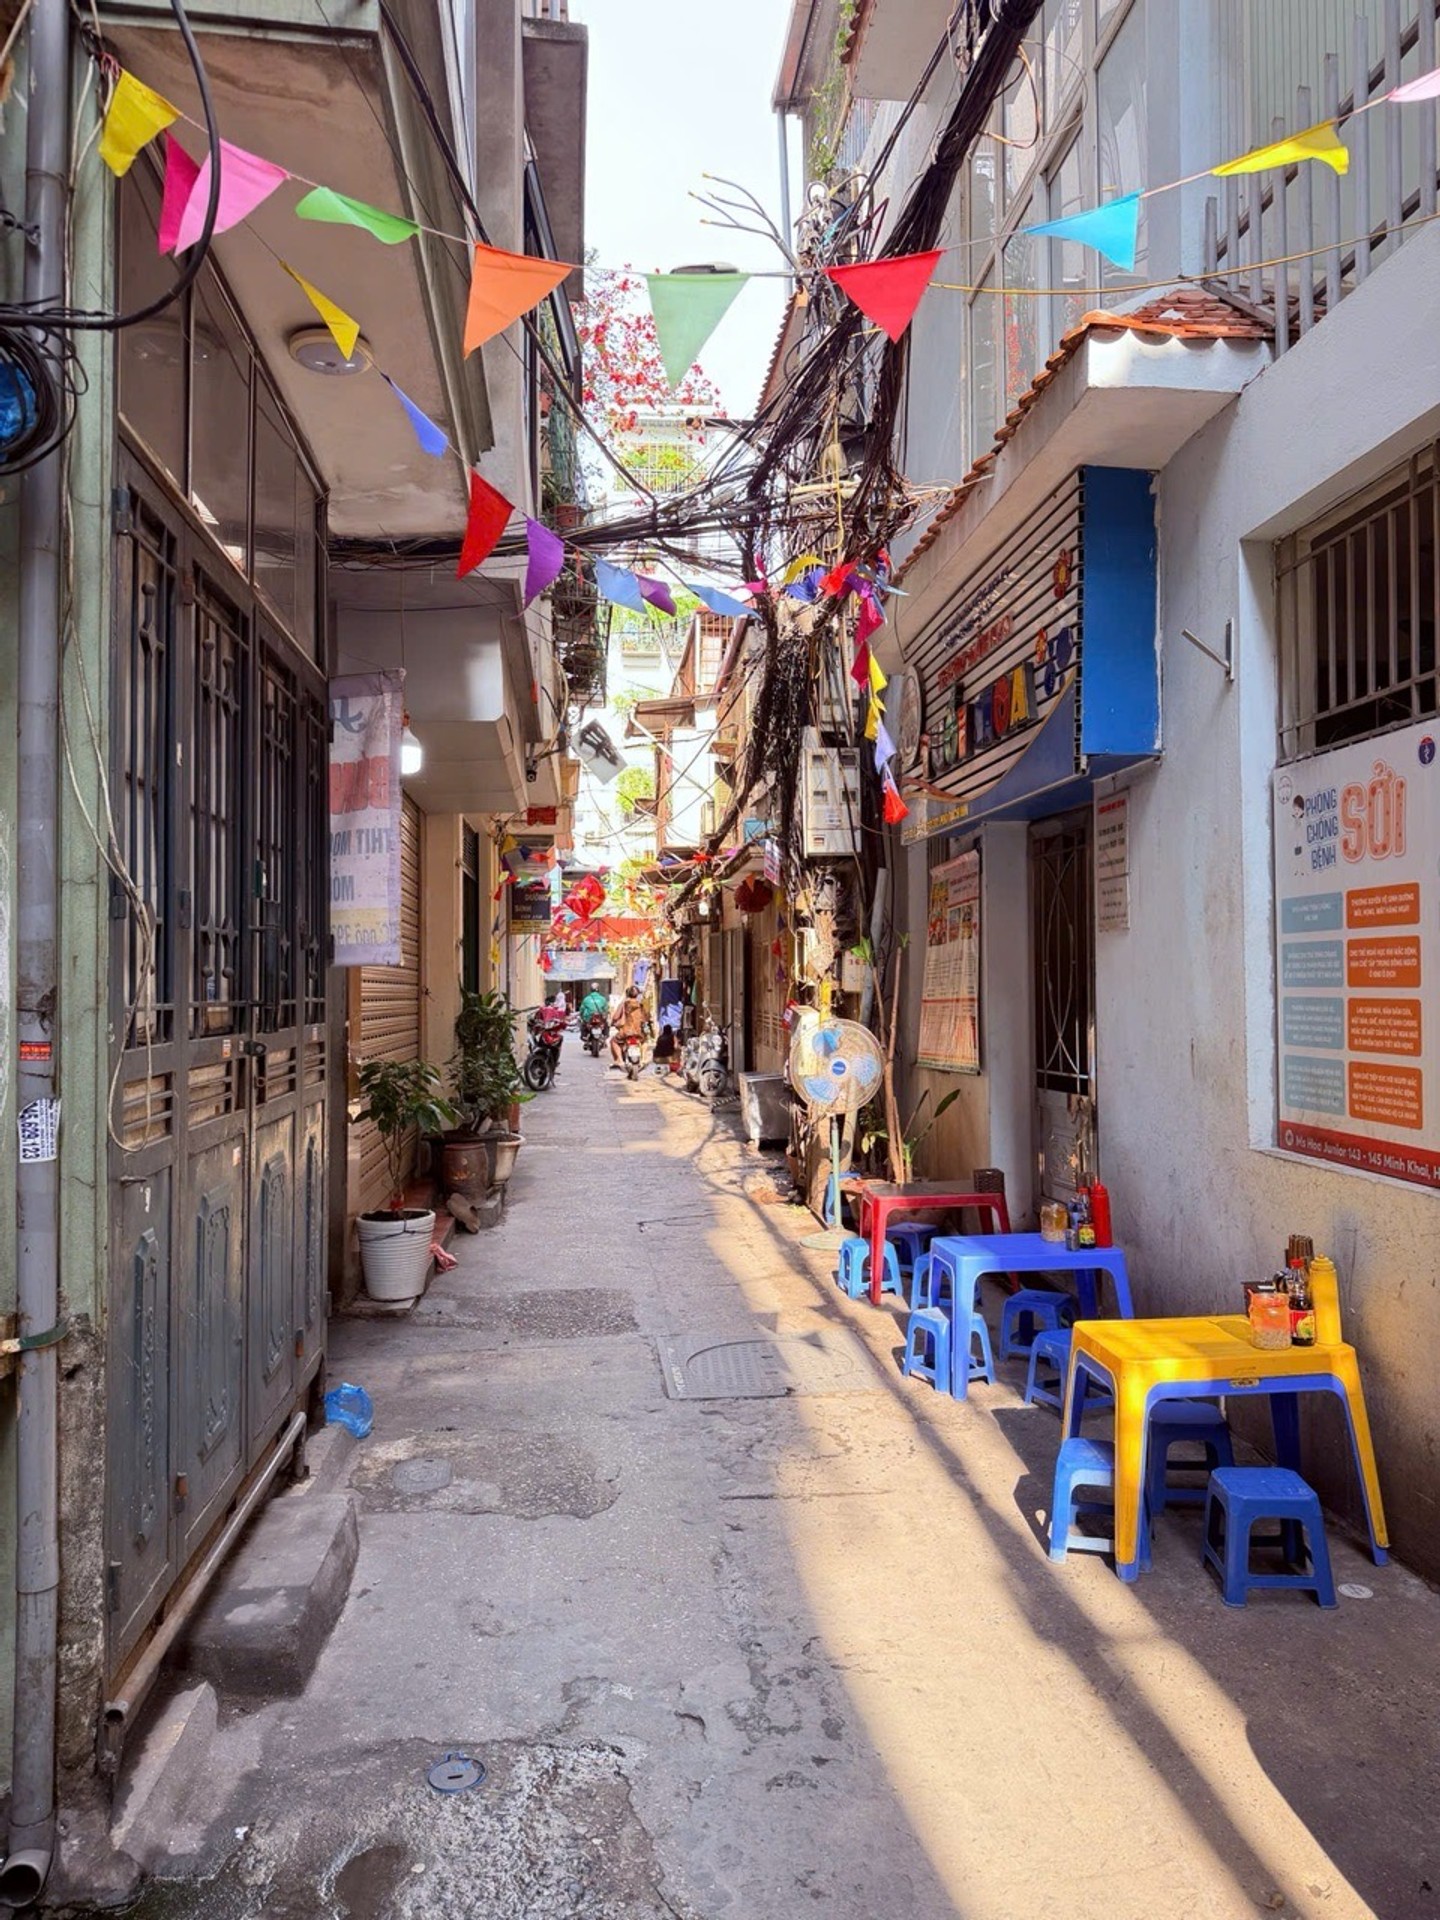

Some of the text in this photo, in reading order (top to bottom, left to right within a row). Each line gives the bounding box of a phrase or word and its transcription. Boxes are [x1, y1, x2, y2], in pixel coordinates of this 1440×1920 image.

[1305, 788, 1338, 817] PHÒNG
[1341, 759, 1406, 863] SỞI
[1306, 814, 1340, 843] CHỐNG
[1311, 844, 1336, 871] BỆNH
[1307, 1137, 1322, 1151] Hoa
[1323, 1141, 1347, 1157] Junior
[1348, 1147, 1362, 1161] 143
[1368, 1152, 1381, 1166] 145
[1384, 1154, 1406, 1170] Minh
[1406, 1159, 1431, 1180] Khai,
